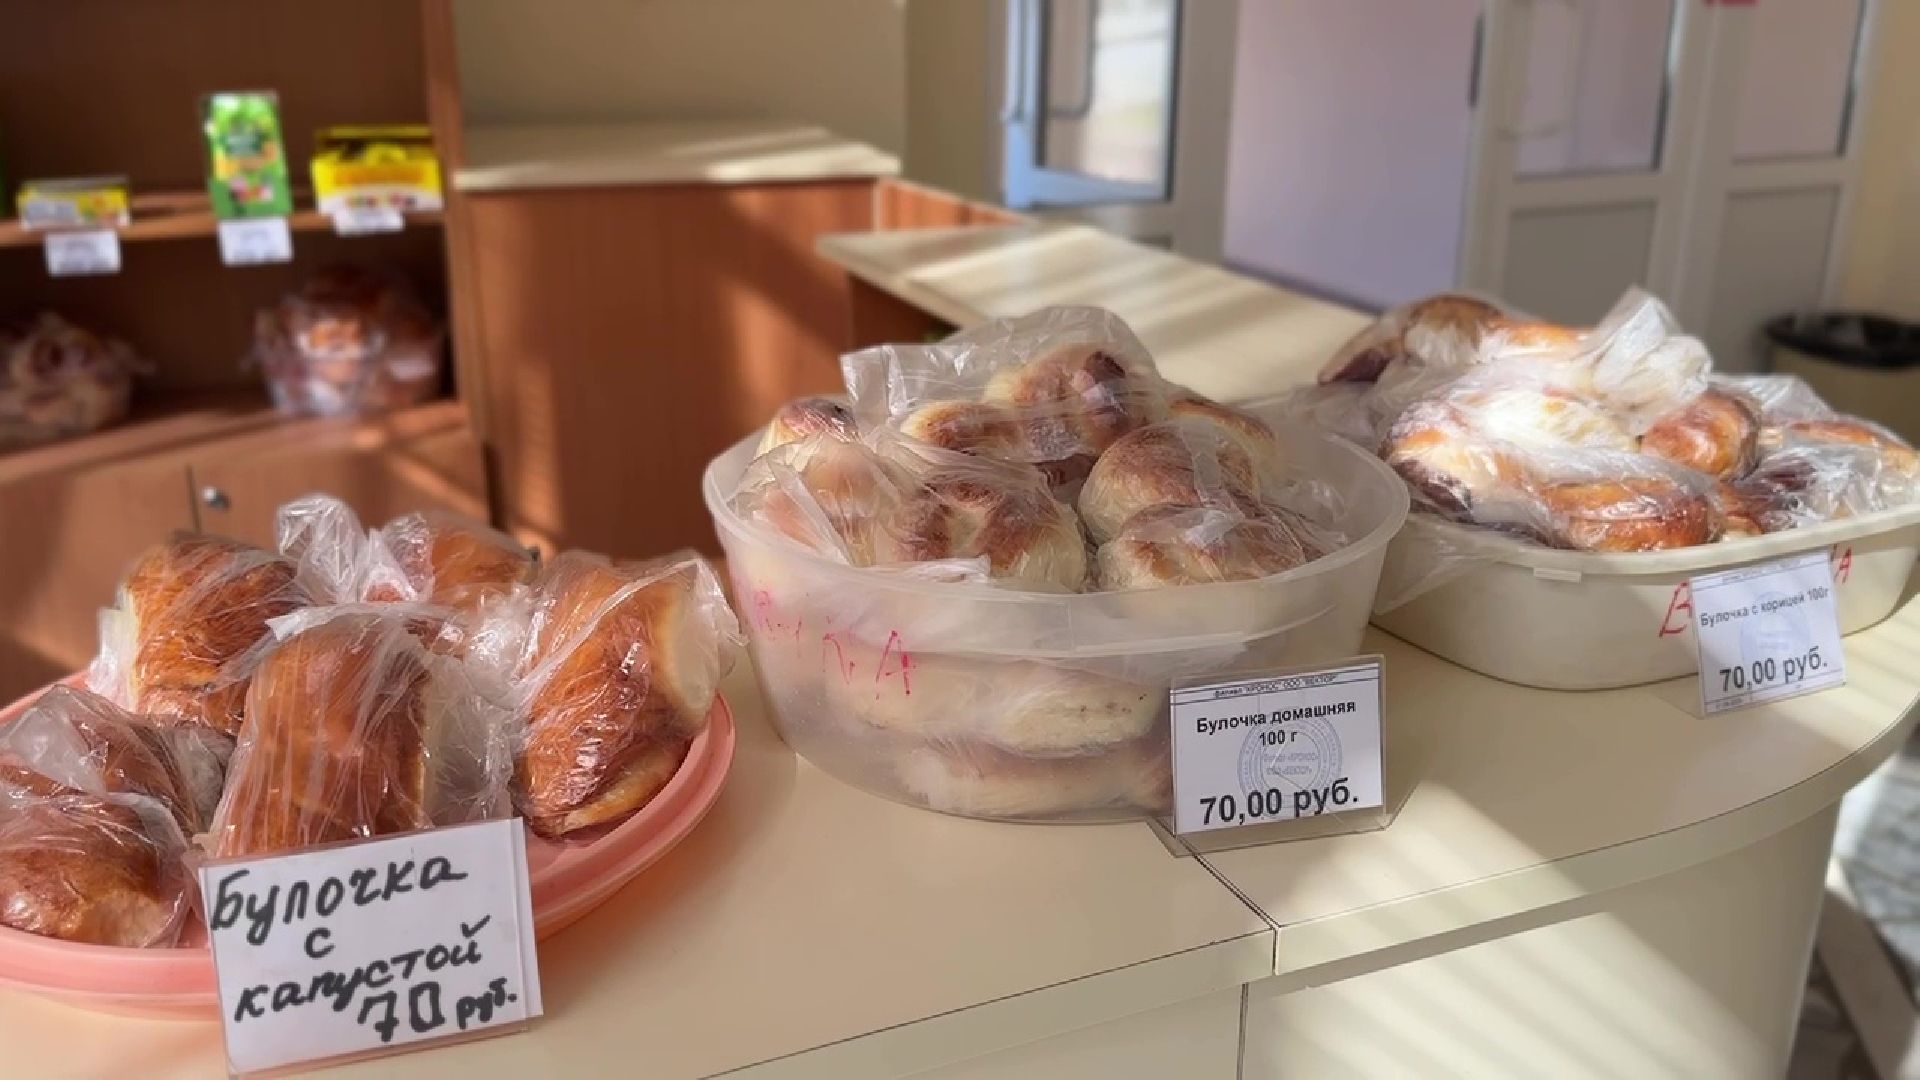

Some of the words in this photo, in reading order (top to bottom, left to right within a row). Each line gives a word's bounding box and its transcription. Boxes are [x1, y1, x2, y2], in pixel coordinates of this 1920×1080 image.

[1700, 608, 1749, 627] Булочка
[1751, 604, 1758, 615] с
[1719, 657, 1776, 691] 70,00
[1783, 646, 1828, 684] руб.
[1196, 713, 1267, 735] Булочка
[1270, 701, 1356, 724] домашняя
[1259, 730, 1285, 746] 100
[1290, 731, 1298, 742] г
[1200, 788, 1282, 825] 70,00
[1294, 777, 1358, 817] руб.
[211, 856, 468, 945] Булочка
[234, 914, 491, 1021] капустой
[357, 980, 446, 1042] 70
[456, 977, 518, 1029] руб.
